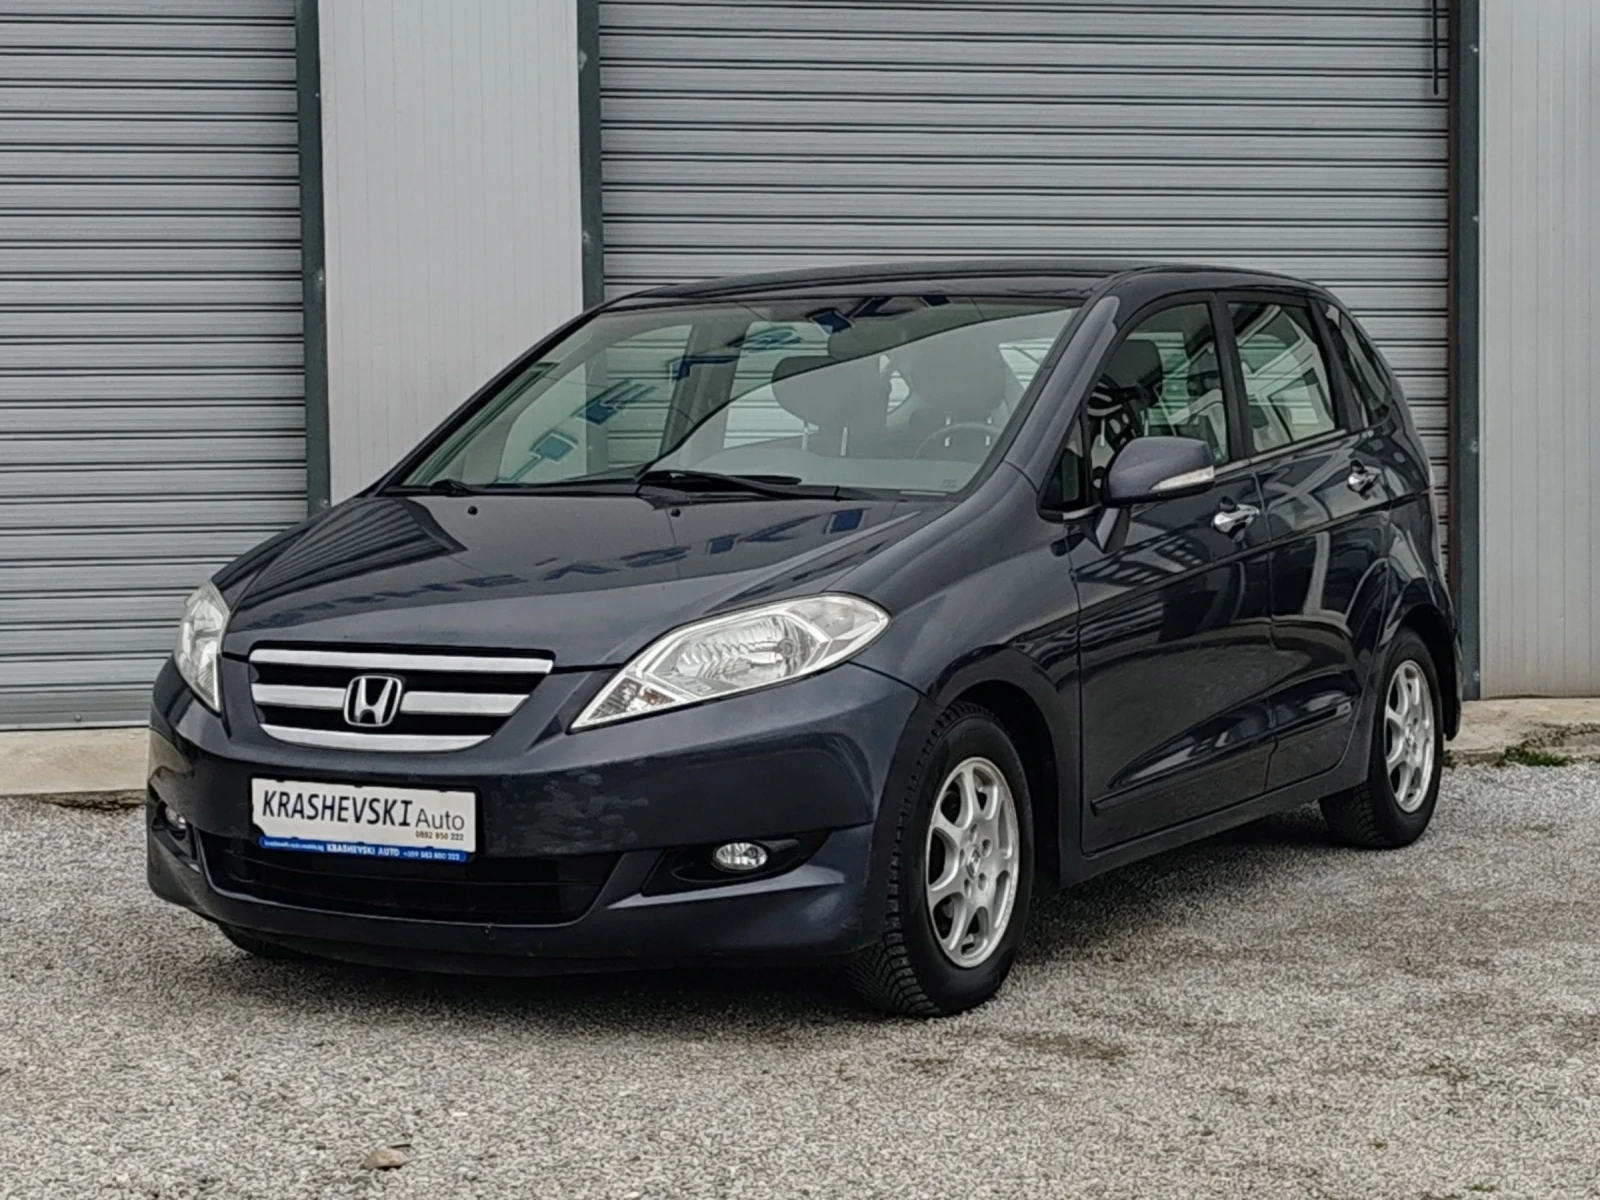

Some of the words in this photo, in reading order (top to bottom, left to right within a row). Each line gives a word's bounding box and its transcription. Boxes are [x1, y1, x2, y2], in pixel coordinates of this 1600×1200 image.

[262, 790, 413, 827] KRASHEVSKI
[415, 808, 465, 831] Auto
[450, 832, 464, 841] 222
[326, 843, 375, 855] KRASHEVSKI
[377, 847, 400, 857] AUTO
